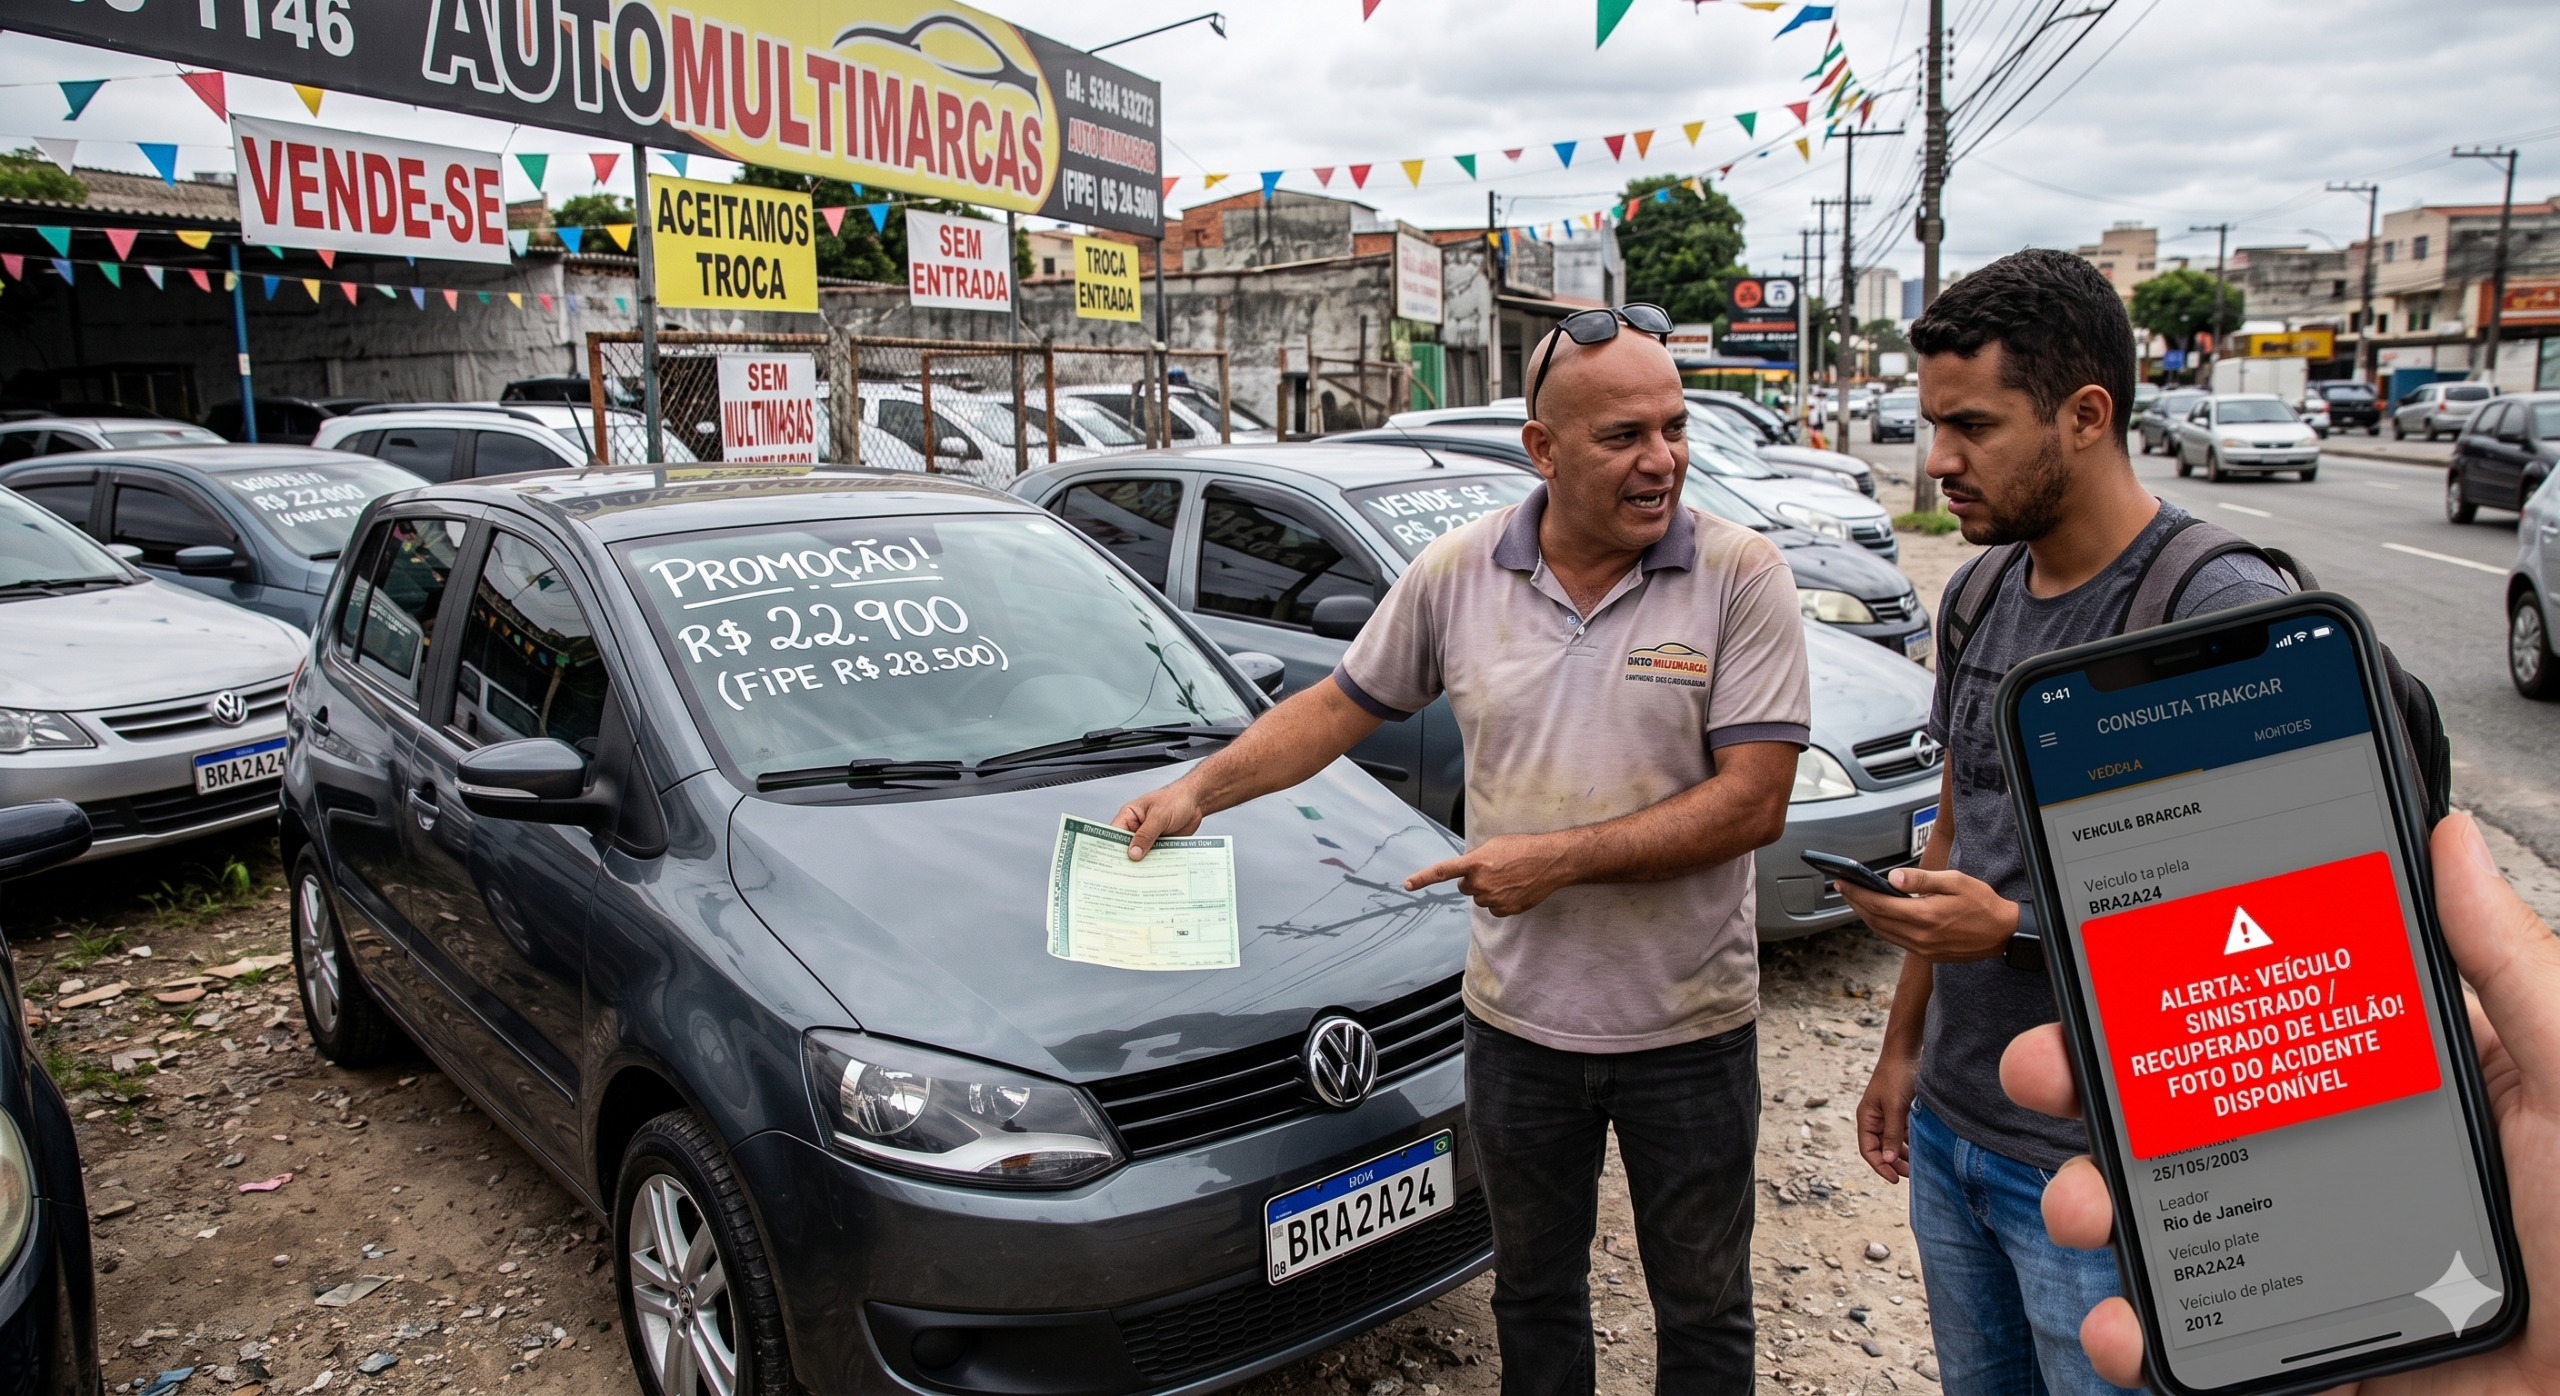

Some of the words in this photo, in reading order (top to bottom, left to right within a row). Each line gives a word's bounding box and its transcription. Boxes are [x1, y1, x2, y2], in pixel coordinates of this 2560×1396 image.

[241, 135, 505, 246] VENDE-SE
[1063, 168, 1098, 216] (FIPE)
[656, 187, 810, 247] ACEITAMOS
[939, 223, 983, 260] SEM
[695, 251, 788, 300] TROCA
[1085, 246, 1128, 278] TROCA
[912, 261, 1009, 302] ENTRADA
[1078, 281, 1135, 313] ENTRADA
[747, 362, 788, 391] SEM
[1367, 488, 1464, 519] VENDE
[1459, 485, 1501, 506] SE
[648, 536, 939, 599] PROMOÇÃO!
[677, 618, 753, 664] R$
[766, 594, 970, 651] 22.900
[830, 655, 881, 685] R$
[883, 635, 1010, 677] 28.500)
[2041, 687, 2071, 704] 9:41
[2096, 698, 2194, 735] CONSULTA
[2194, 677, 2284, 712] TRAKCAR
[204, 751, 285, 789] BRA2A24
[2135, 801, 2203, 828] BRARCAR
[2139, 868, 2156, 881] ta
[2156, 859, 2191, 880] plela
[2088, 885, 2163, 915] BRA2A24
[2160, 973, 2252, 1012] ALERTA:
[2255, 947, 2352, 988] VEÍCULO
[2185, 984, 2322, 1035] SINISTRADO
[2328, 977, 2336, 1004] /
[2130, 1023, 2280, 1077] RECUPERADO
[2284, 1014, 2316, 1042] DE
[2318, 993, 2406, 1033] LEILÃO!
[2166, 1065, 2227, 1099] FOTO
[2230, 1057, 2264, 1083] DO
[2270, 1028, 2381, 1075] ACIDENTE
[2212, 1067, 2349, 1118] DISPONÍVEL
[2151, 1147, 2250, 1182] 25/105/2003
[1286, 1166, 1437, 1267] BRA2A24
[2158, 1190, 2210, 1213] Leador
[2162, 1215, 2190, 1233] Rio
[2192, 1209, 2213, 1226] de
[2215, 1196, 2274, 1221] Janeiro
[2168, 1238, 2222, 1261] Veículo
[2223, 1231, 2261, 1252] plate
[2172, 1253, 2246, 1283] BRA2A24
[2239, 1283, 2259, 1298] de
[2260, 1274, 2305, 1297] plates
[2183, 1311, 2225, 1333] 2012
